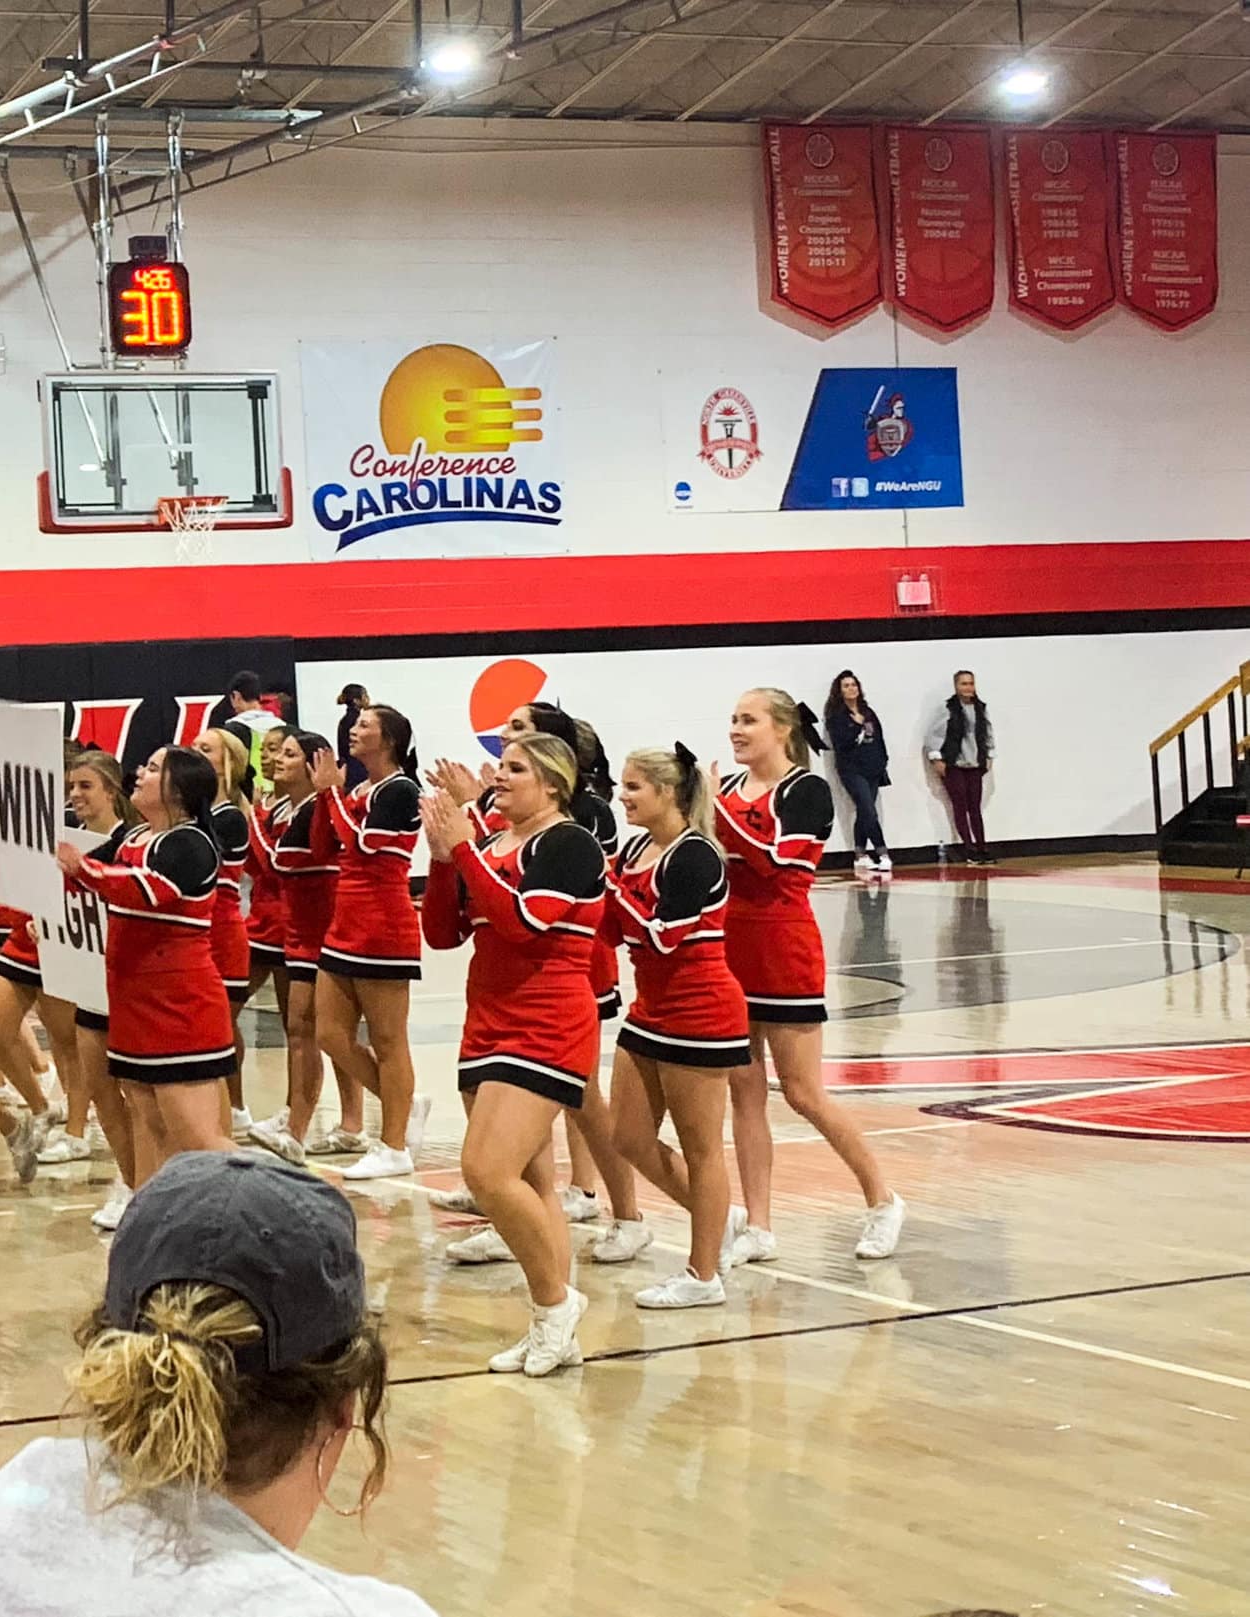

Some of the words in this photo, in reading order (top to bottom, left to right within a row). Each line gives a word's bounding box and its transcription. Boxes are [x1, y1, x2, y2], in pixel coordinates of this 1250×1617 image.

[120, 290, 183, 344] 30
[349, 442, 517, 491] Conference
[875, 480, 942, 492] #WeAreNGU
[312, 476, 563, 532] CAROLINAS
